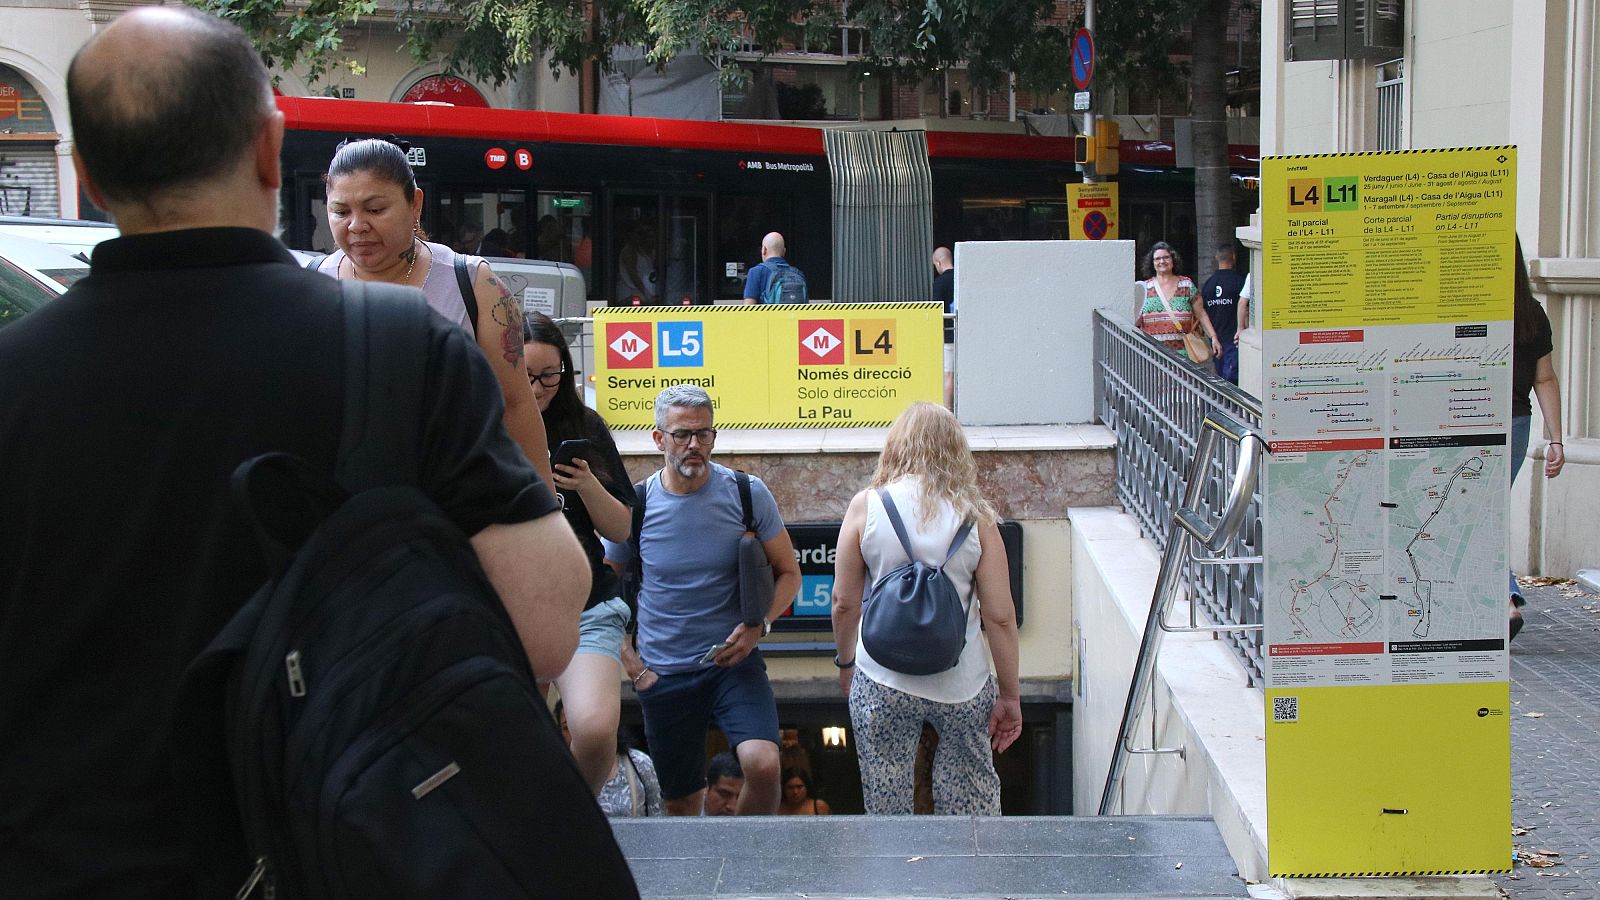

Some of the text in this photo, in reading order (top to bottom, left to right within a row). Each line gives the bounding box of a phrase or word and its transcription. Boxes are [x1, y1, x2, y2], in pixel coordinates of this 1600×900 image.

[519, 153, 529, 166] B
[747, 161, 814, 172] AMB Bus Metropolità
[1364, 174, 1403, 183] Verdaguer
[1406, 173, 1420, 181] (L4)
[1427, 172, 1447, 180] Casa
[1461, 170, 1488, 179] l'Aigua
[1490, 169, 1509, 177] (L11)
[1290, 184, 1356, 206] L4 L11
[1364, 195, 1397, 203] Maragall
[1399, 194, 1414, 202] (L4)
[1421, 193, 1441, 201] Casa
[1443, 192, 1453, 200] de
[1455, 191, 1482, 200] l'Aigua
[1484, 190, 1503, 198] (L11)
[1364, 215, 1412, 224] Corte parcial
[1435, 212, 1503, 221] Partial disruptions
[1302, 219, 1328, 228] parcial
[1321, 228, 1334, 236] L11
[662, 330, 700, 356] L5
[855, 330, 892, 354] L4
[798, 367, 912, 380] Només direcció
[608, 376, 656, 388] Servei
[798, 386, 896, 399] Solo dirección
[798, 406, 852, 418] La Pau
[797, 584, 830, 607] L5
